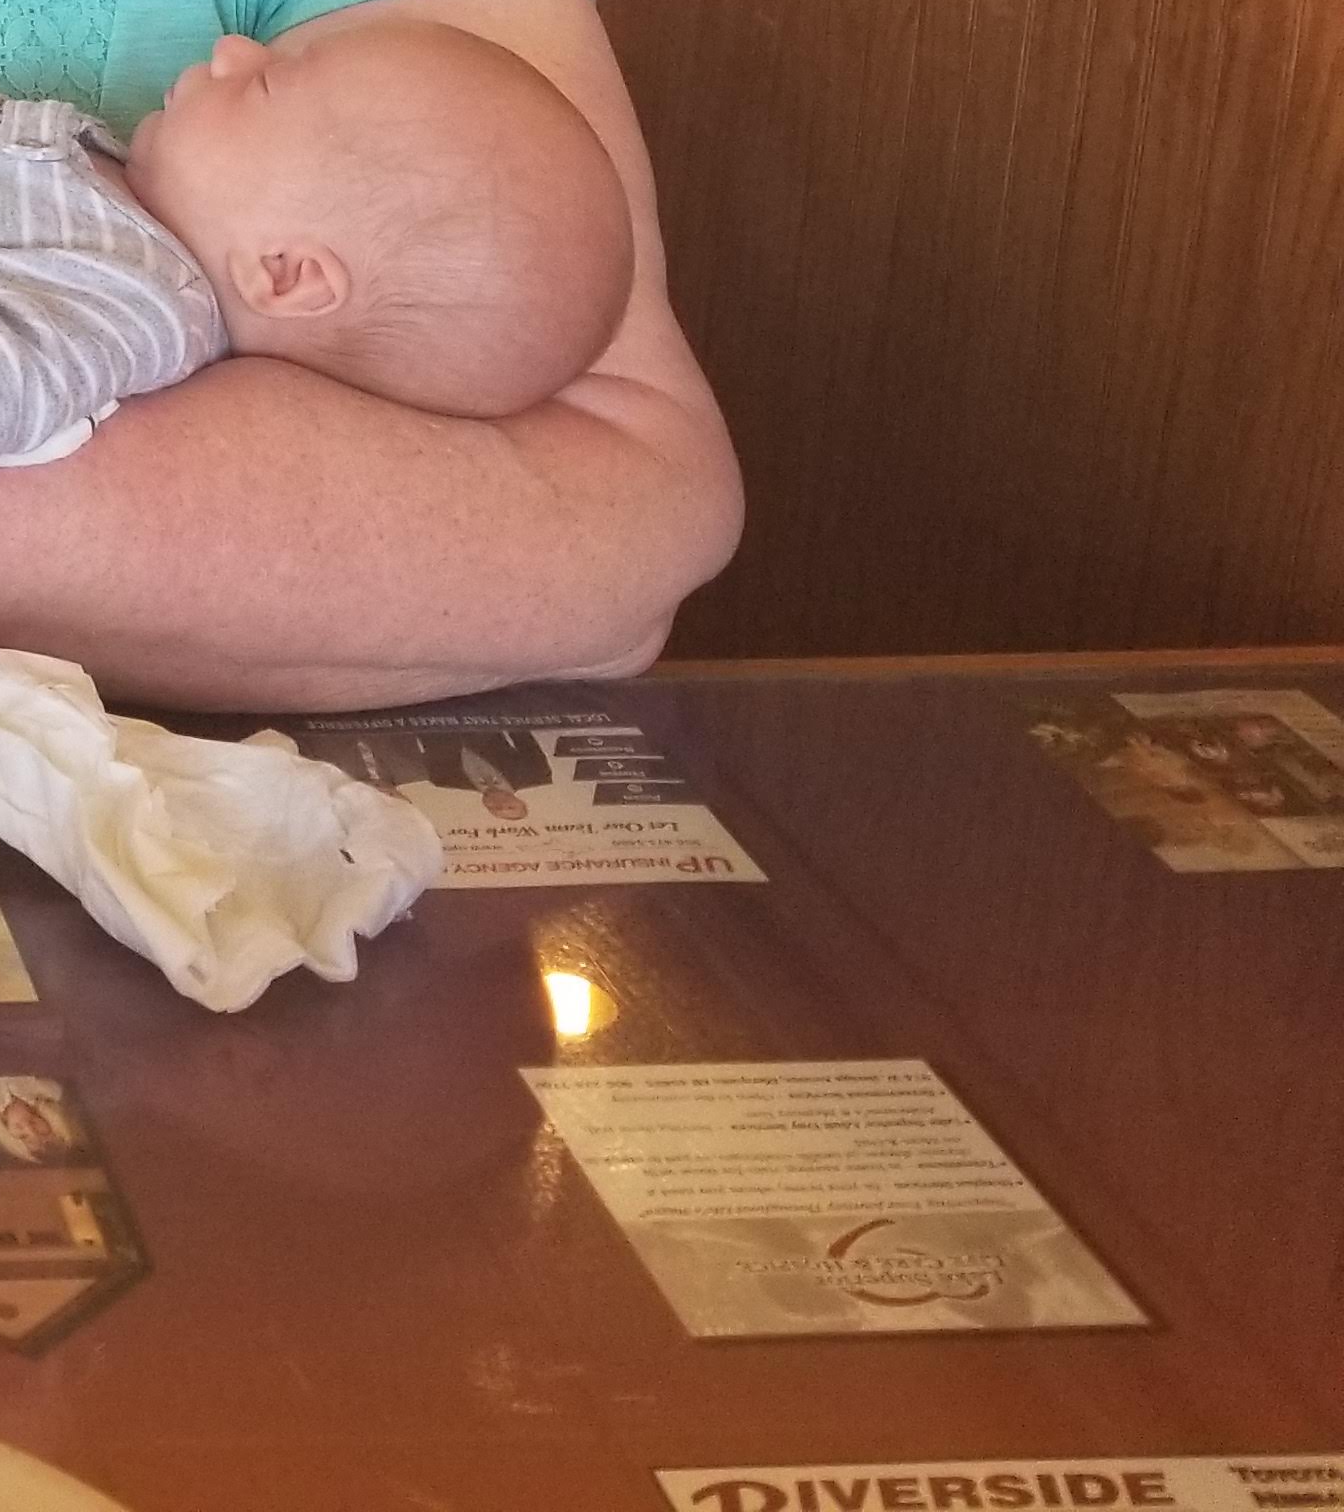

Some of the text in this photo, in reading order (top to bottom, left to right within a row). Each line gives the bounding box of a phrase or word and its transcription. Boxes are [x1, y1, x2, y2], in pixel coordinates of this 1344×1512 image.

[486, 827, 539, 838] Work
[544, 824, 599, 835] Team
[603, 823, 643, 832] Our
[649, 822, 678, 832] Let
[544, 858, 671, 872] INSURANCE
[675, 856, 734, 873] UP
